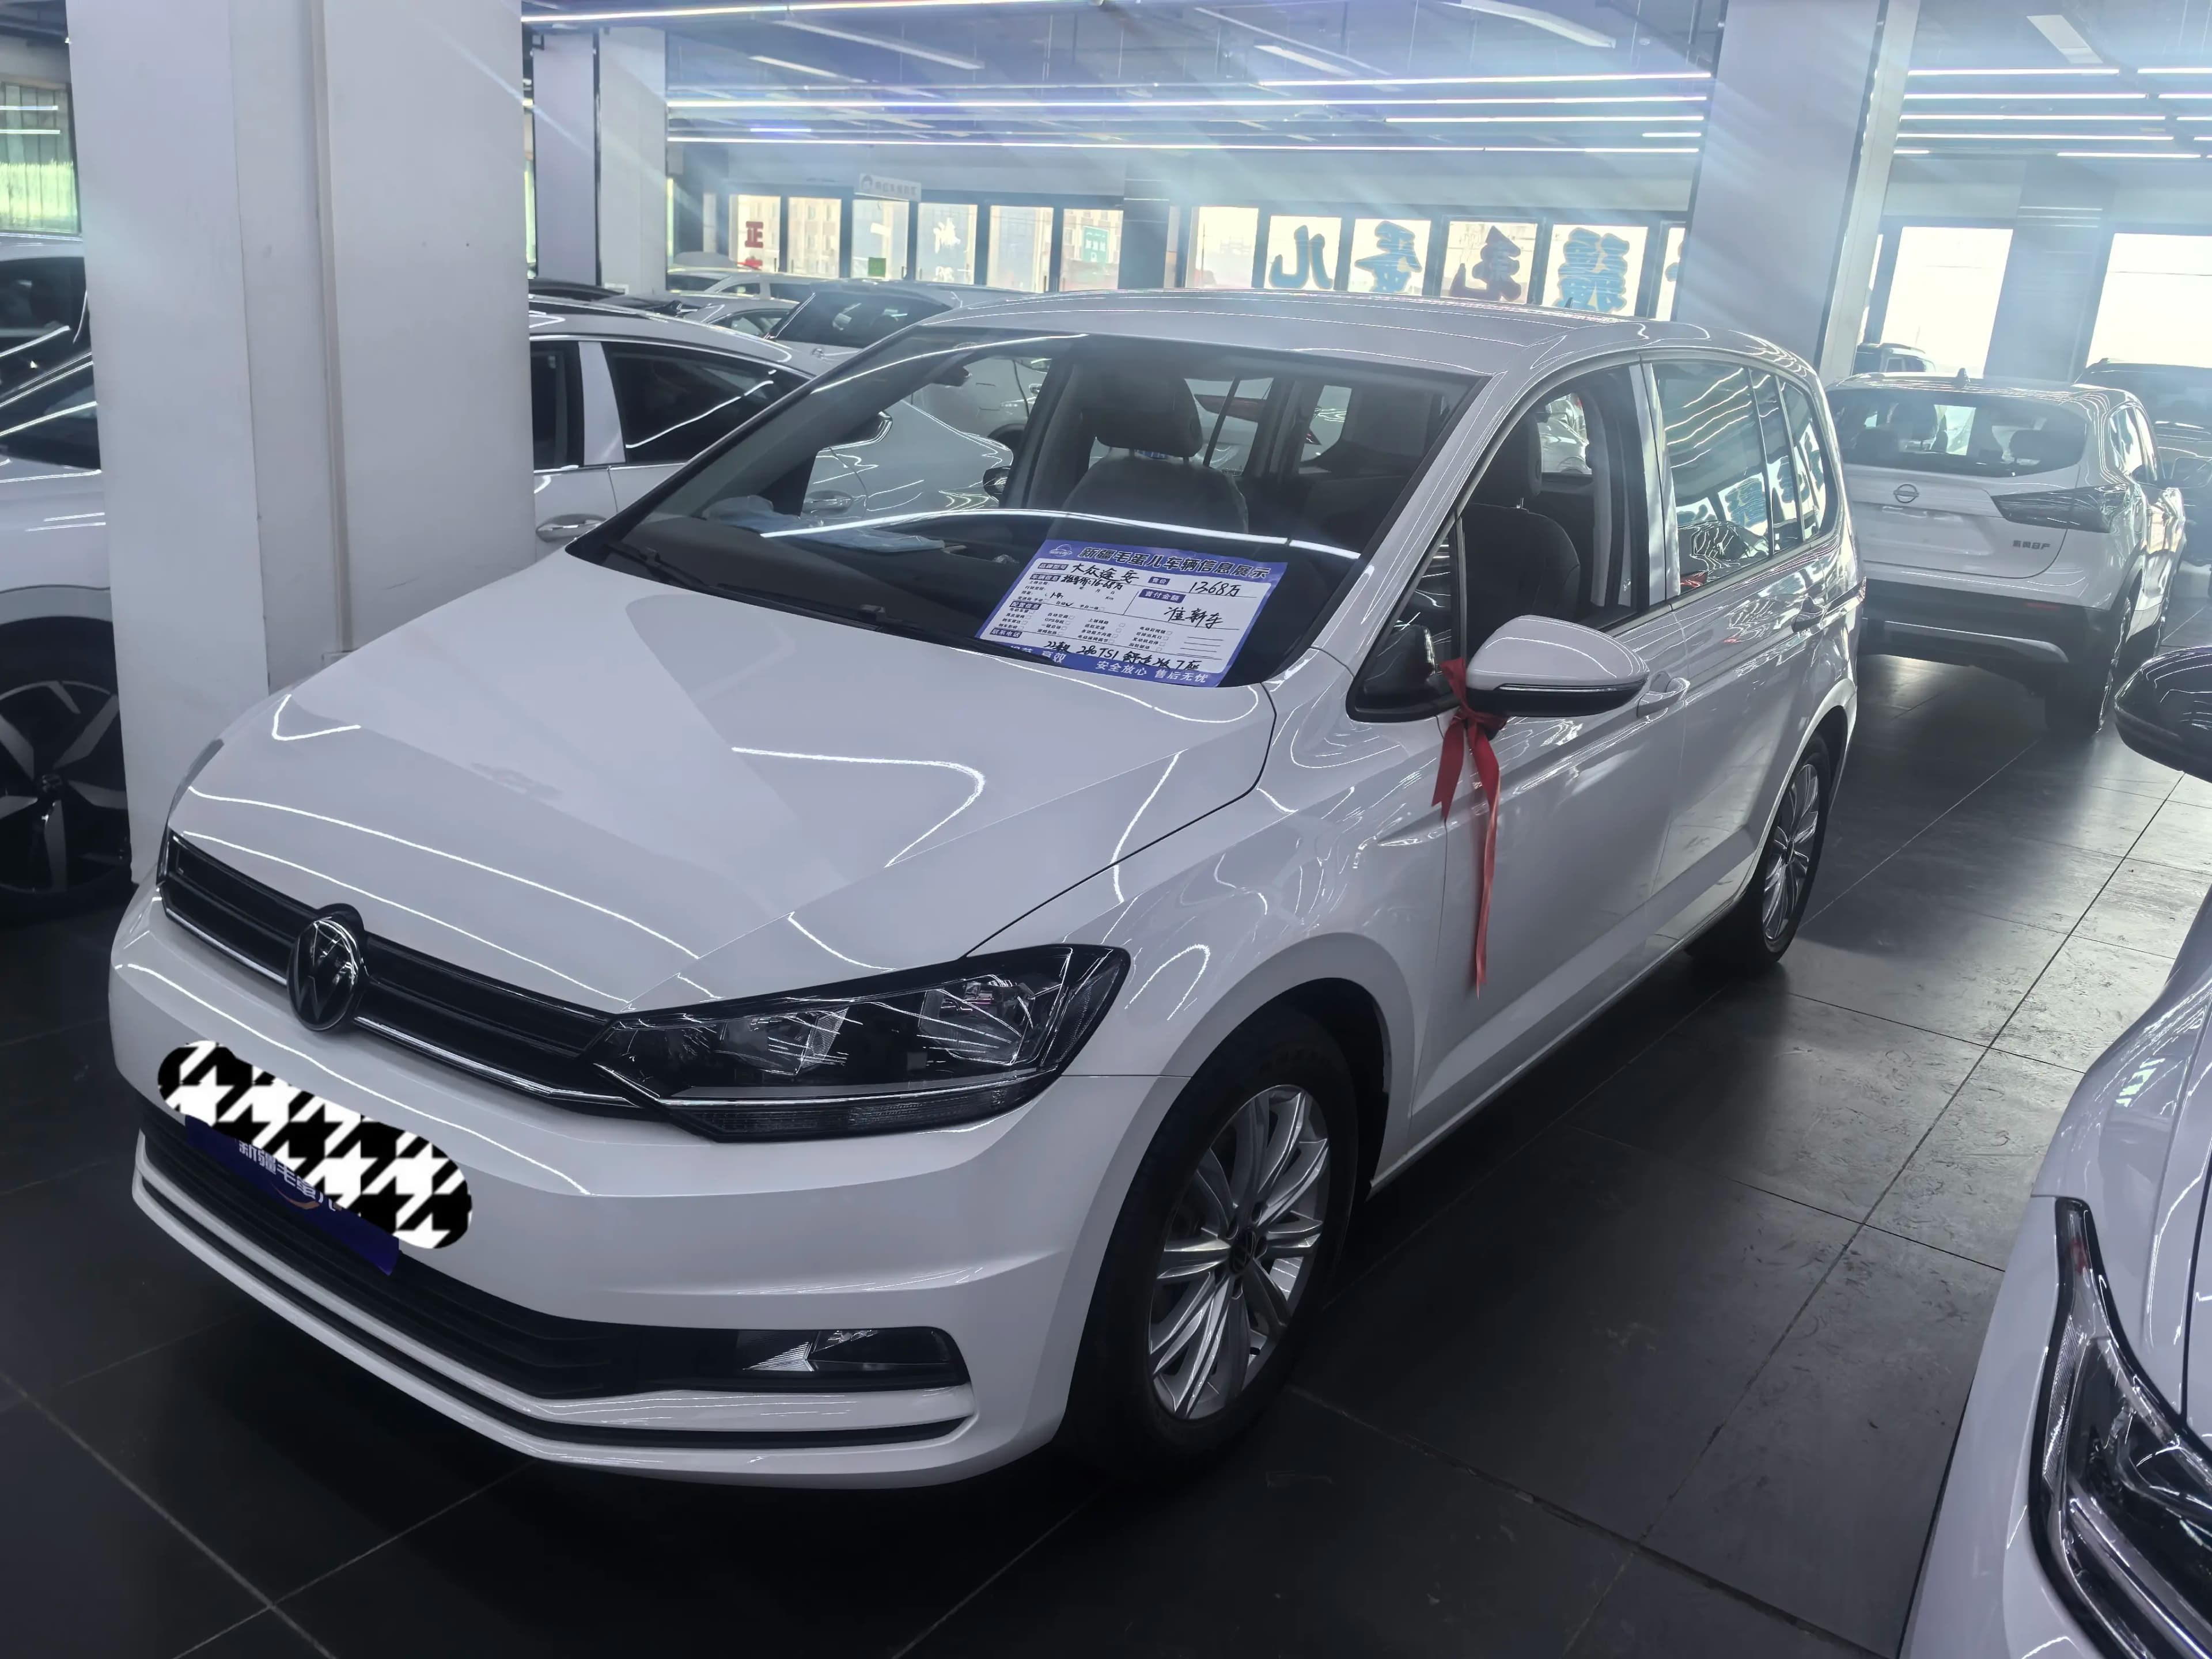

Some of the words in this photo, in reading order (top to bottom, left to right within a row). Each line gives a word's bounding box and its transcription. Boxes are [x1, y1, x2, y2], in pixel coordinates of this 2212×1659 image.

[1078, 547, 1271, 579] 新疆毛蛋儿车辆信息展示
[1145, 590, 1180, 601] 首付金额
[1011, 601, 1040, 610] 配置信息
[1164, 607, 1224, 629] 准新车
[991, 628, 1021, 638] 联系电话
[1081, 628, 1112, 637] 多功能方向盘
[1095, 660, 1147, 676] 安全放心
[1154, 668, 1209, 683] 售后无忧
